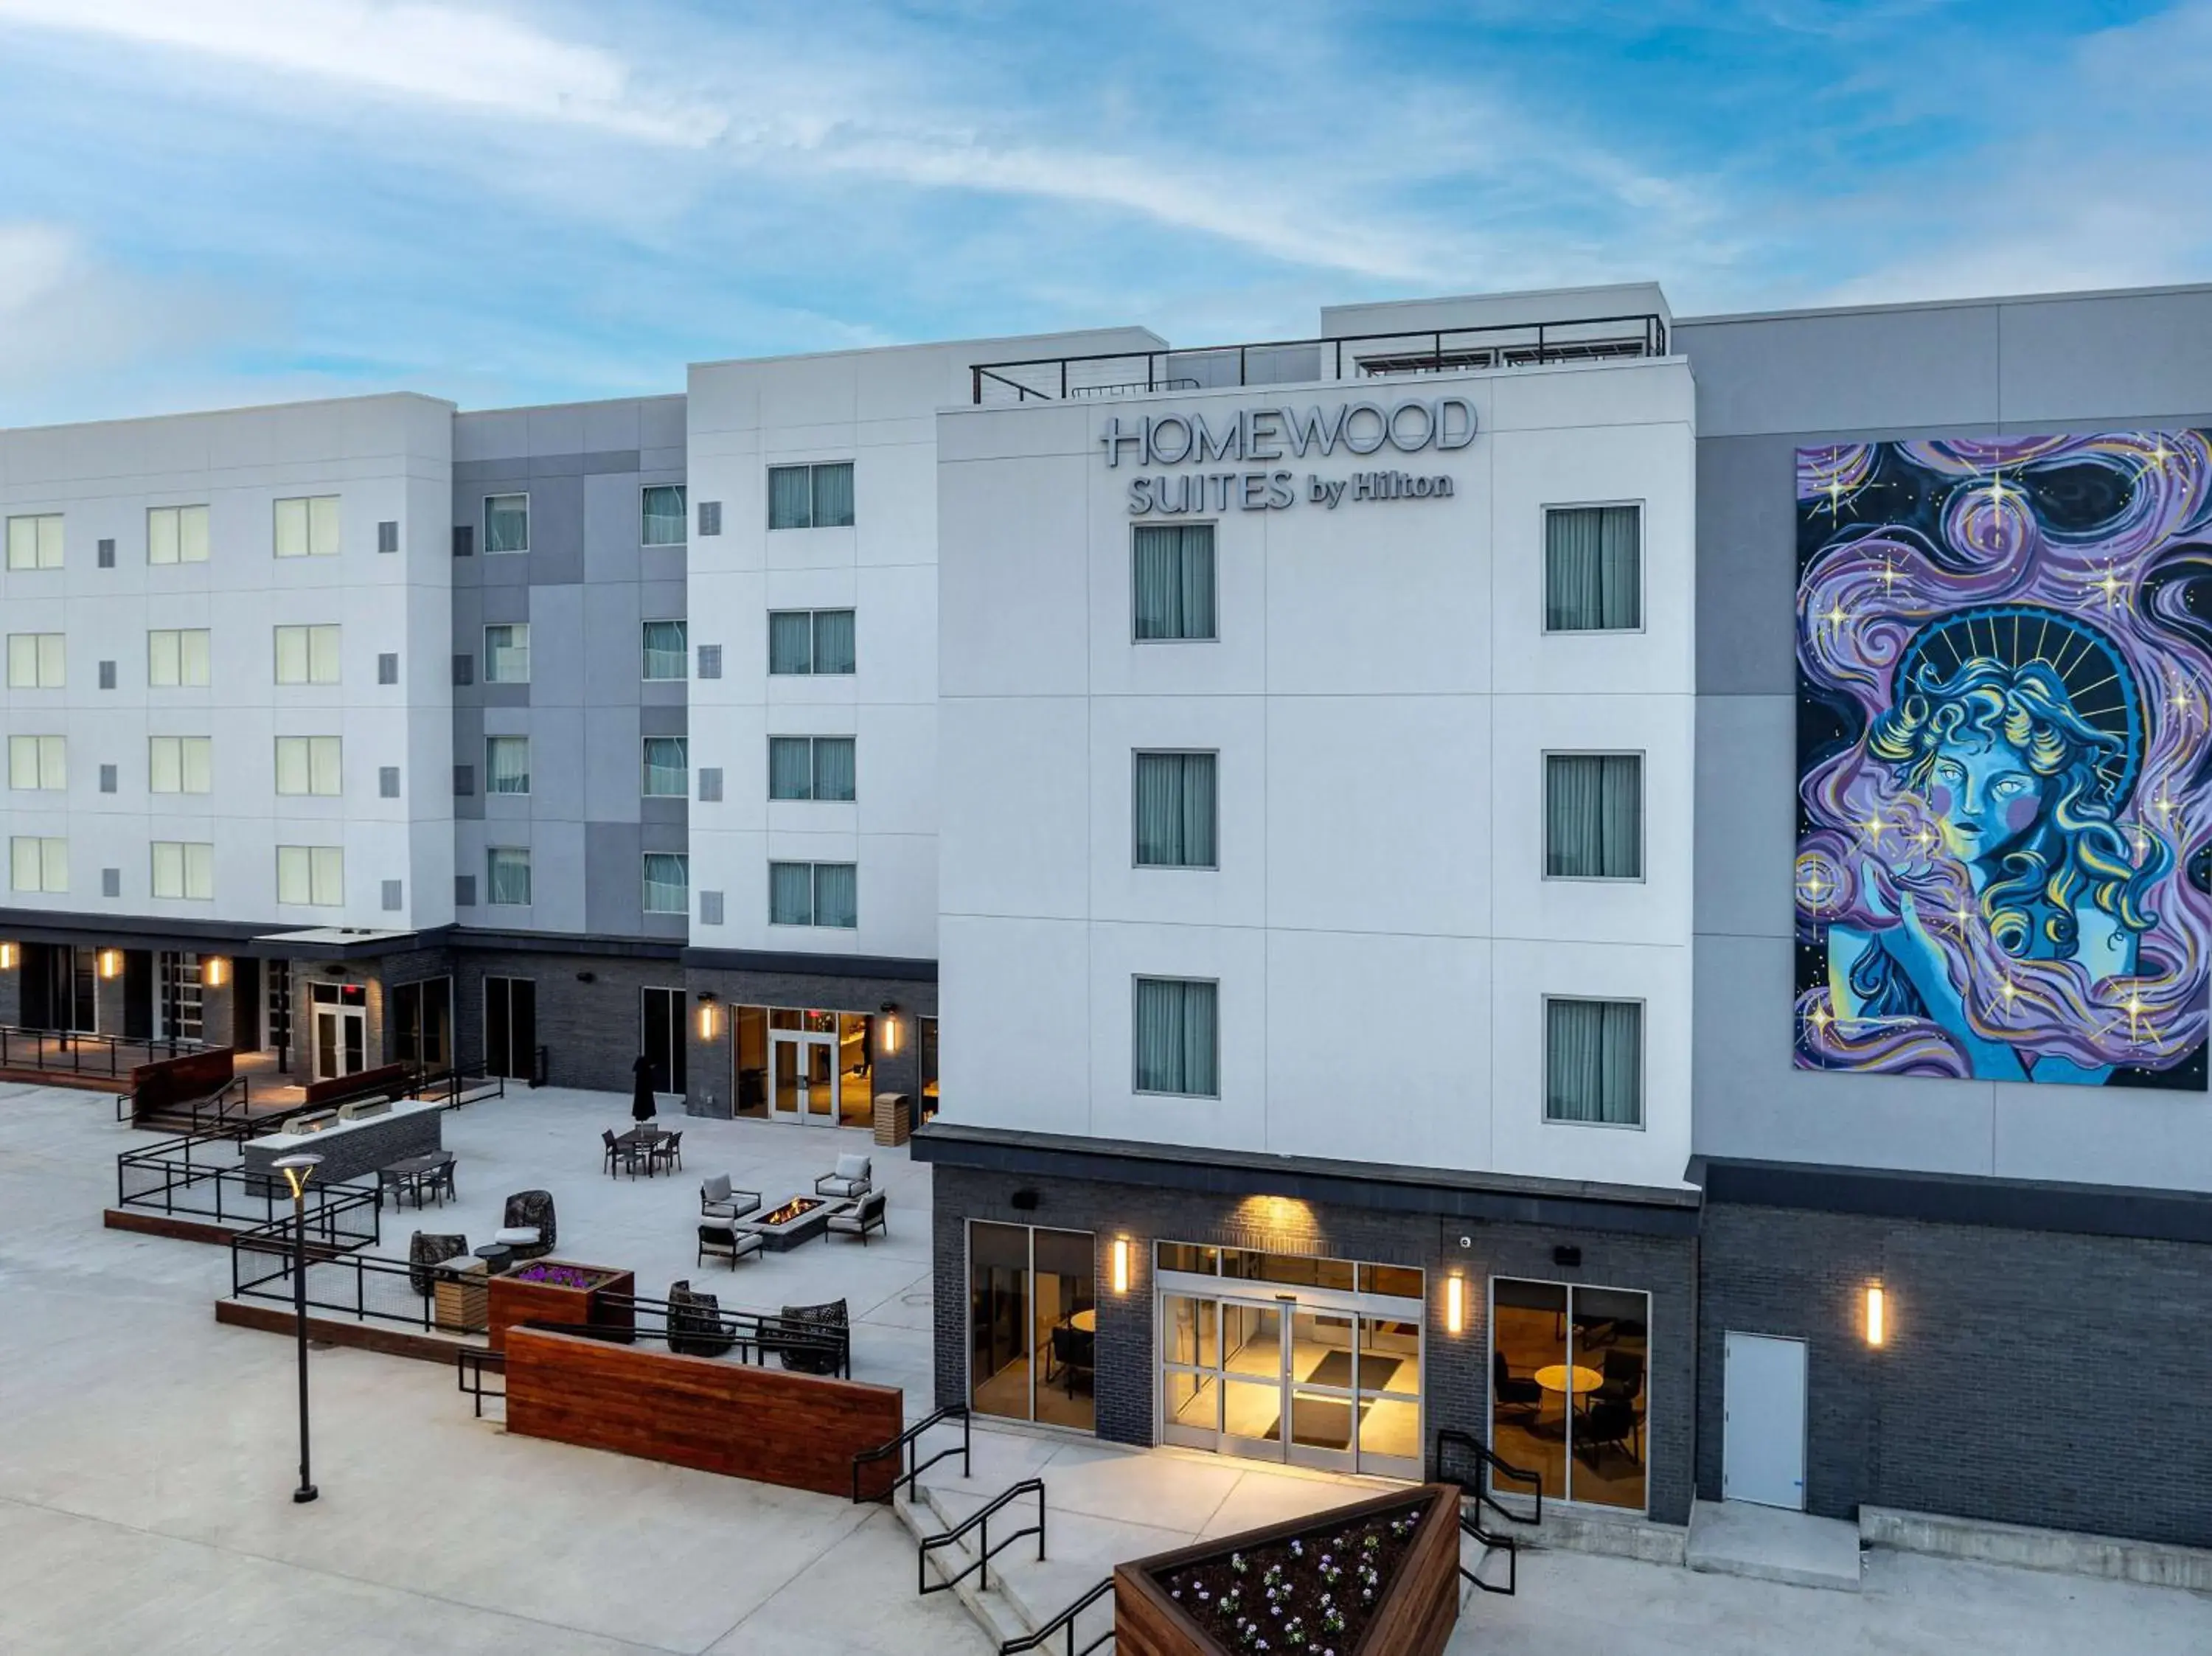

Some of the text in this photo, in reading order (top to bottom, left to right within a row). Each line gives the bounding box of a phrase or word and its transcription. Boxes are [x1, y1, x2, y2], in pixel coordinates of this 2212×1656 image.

[1100, 397, 1478, 467] HOMEWOOD
[1127, 470, 1454, 515] SUITES by Hilton
